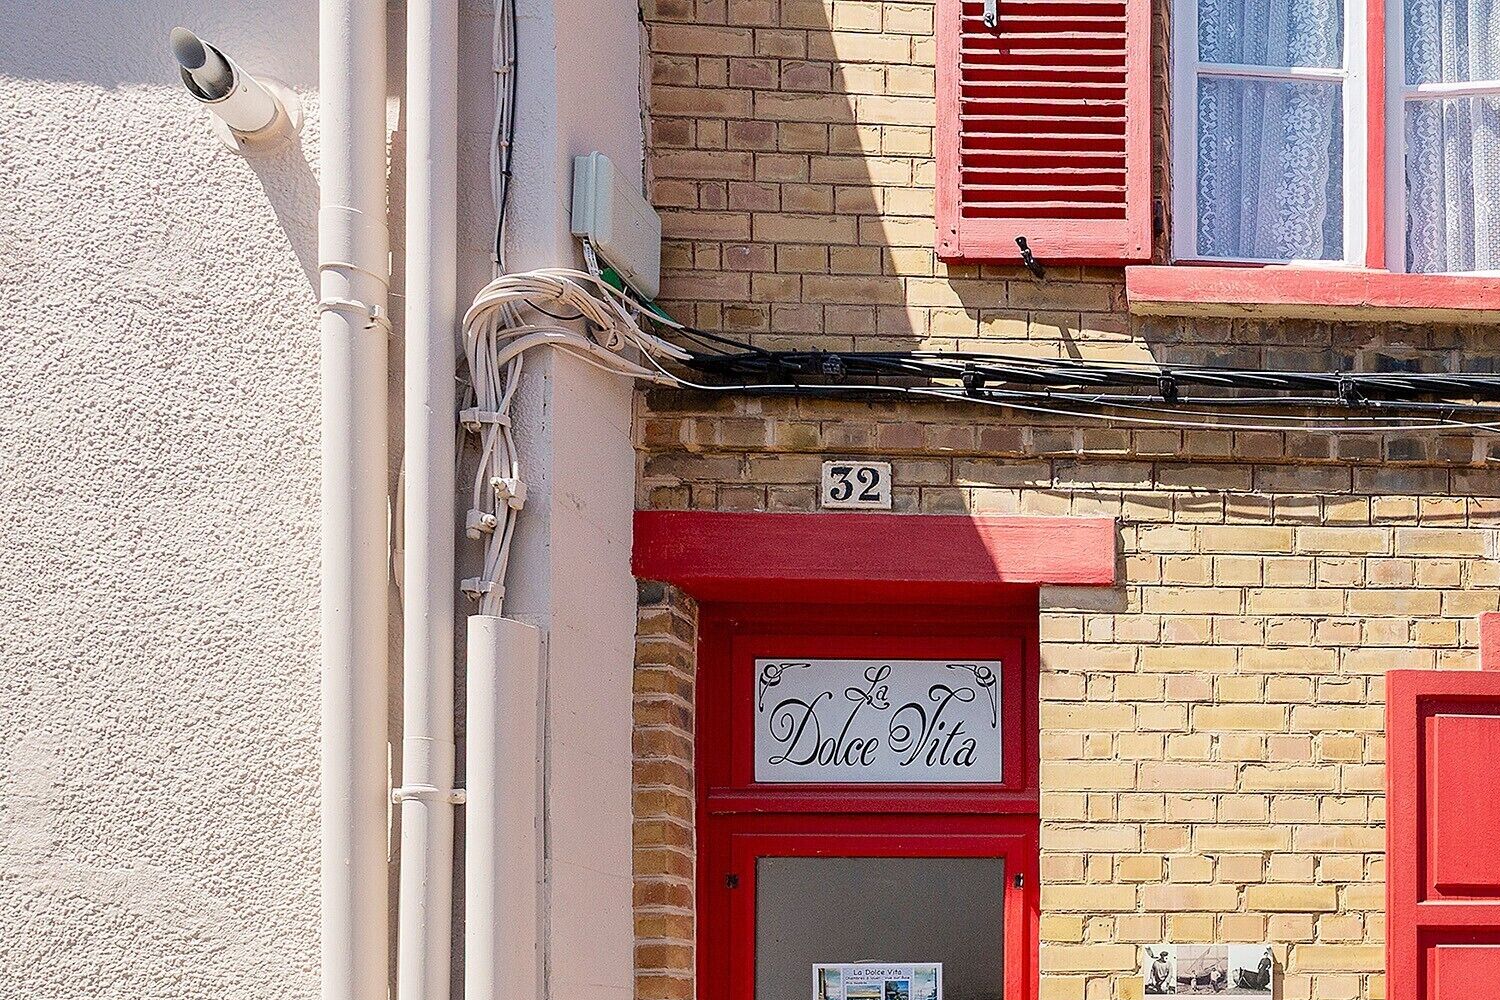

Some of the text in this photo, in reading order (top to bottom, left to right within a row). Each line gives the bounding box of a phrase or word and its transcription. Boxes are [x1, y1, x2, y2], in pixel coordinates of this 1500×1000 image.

[830, 466, 881, 501] 32
[844, 665, 893, 710] La
[768, 684, 978, 767] Dolce Vita
